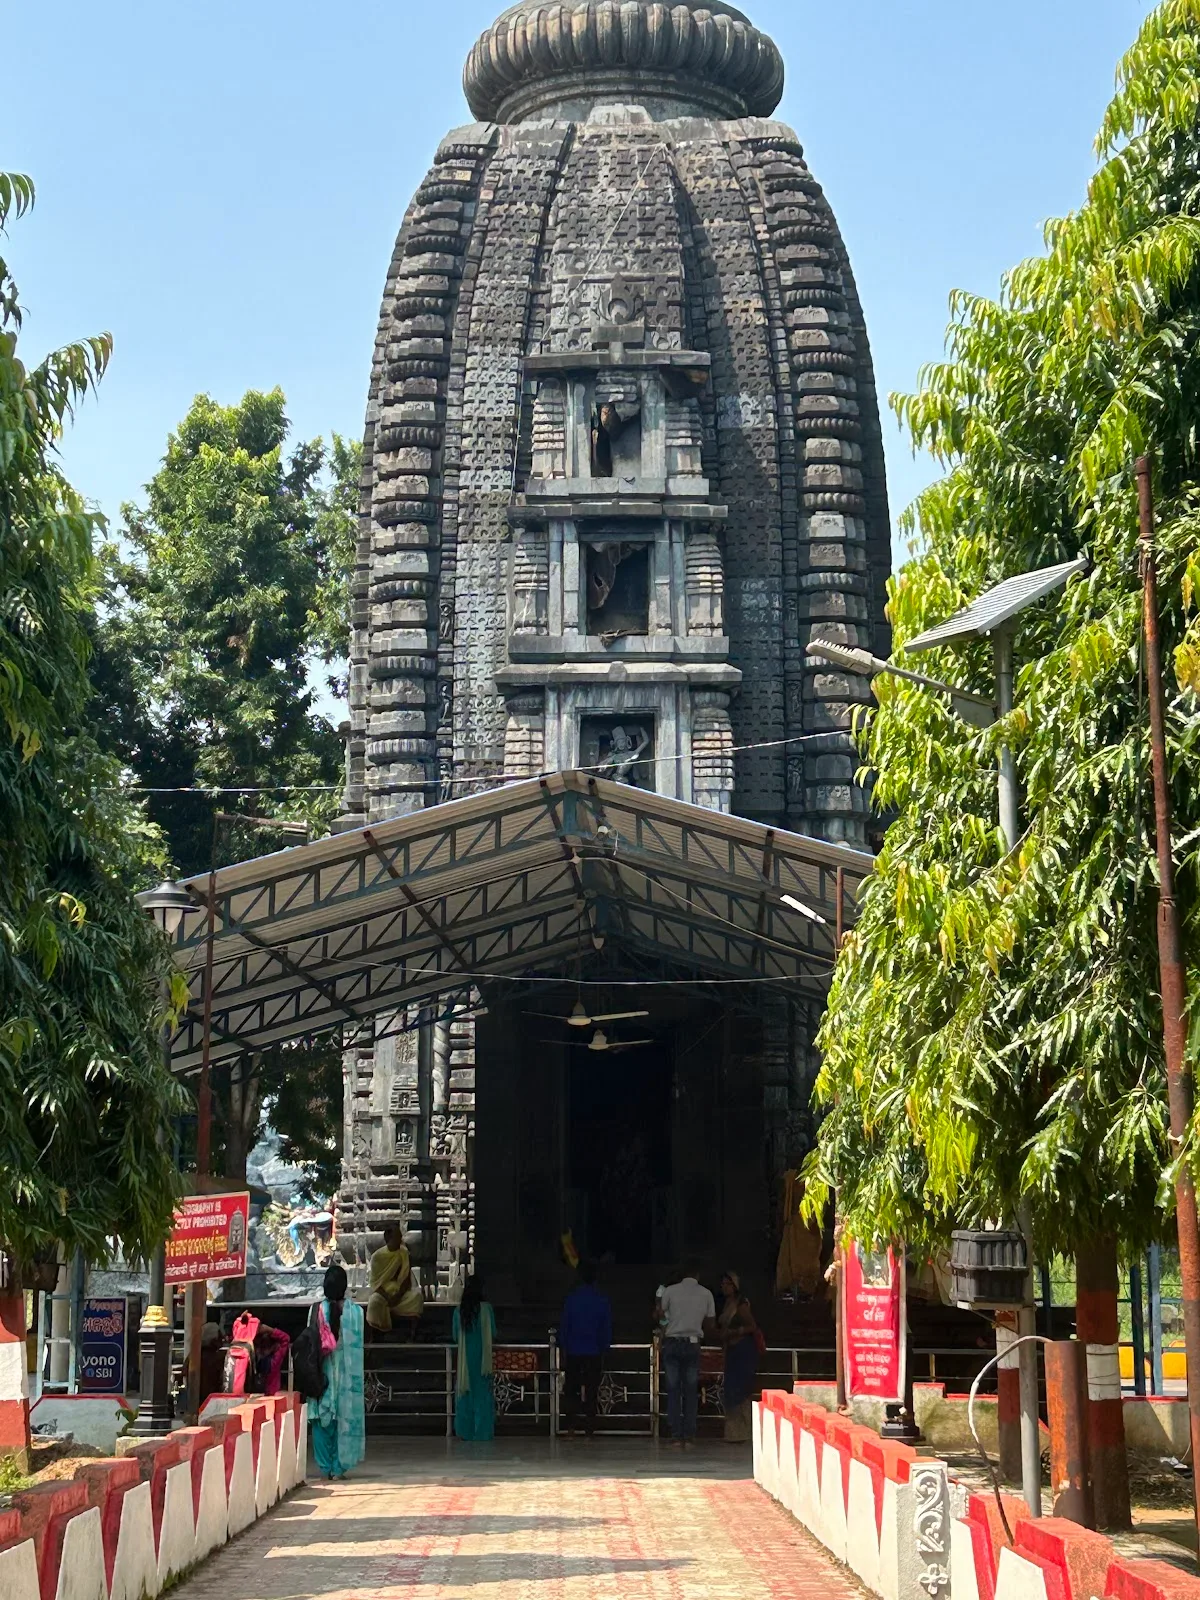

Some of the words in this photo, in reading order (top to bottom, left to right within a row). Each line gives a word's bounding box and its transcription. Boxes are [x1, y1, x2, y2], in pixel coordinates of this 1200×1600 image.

[215, 1201, 221, 1212] IS
[193, 1214, 227, 1228] PROHIBITED
[82, 1355, 116, 1369] yono
[95, 1368, 113, 1378] SBI
